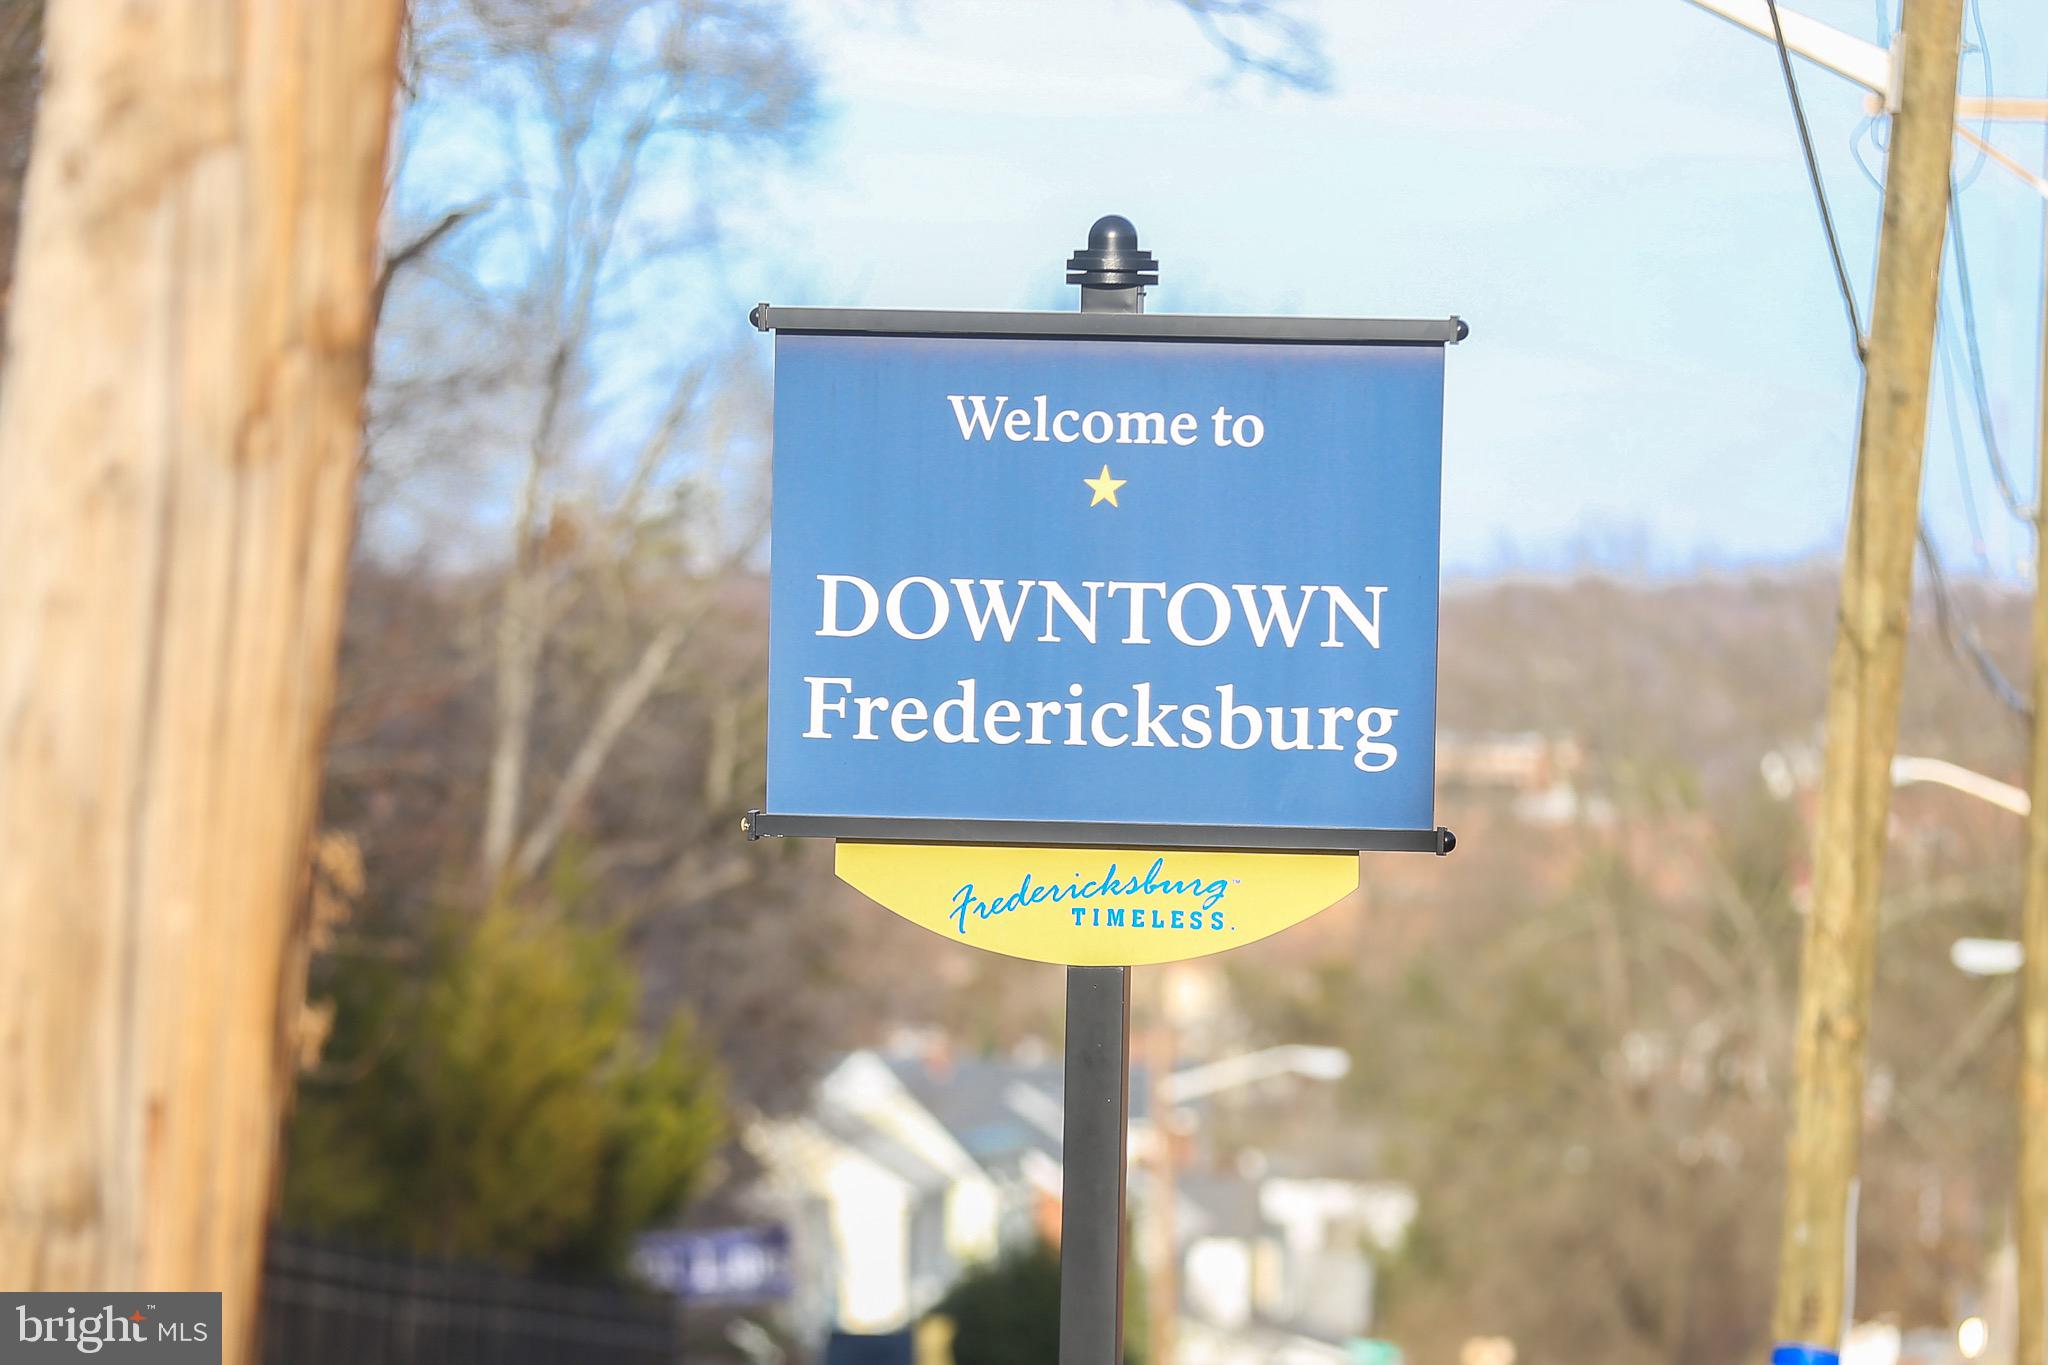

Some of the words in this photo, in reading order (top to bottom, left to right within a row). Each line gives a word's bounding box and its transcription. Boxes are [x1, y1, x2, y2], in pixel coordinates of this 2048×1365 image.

[946, 394, 1198, 446] Welcome
[1211, 406, 1265, 448] to
[815, 574, 1389, 649] DOWNTOWN
[802, 676, 1399, 773] Fredericksburg
[949, 857, 1228, 934] Fredericksburg
